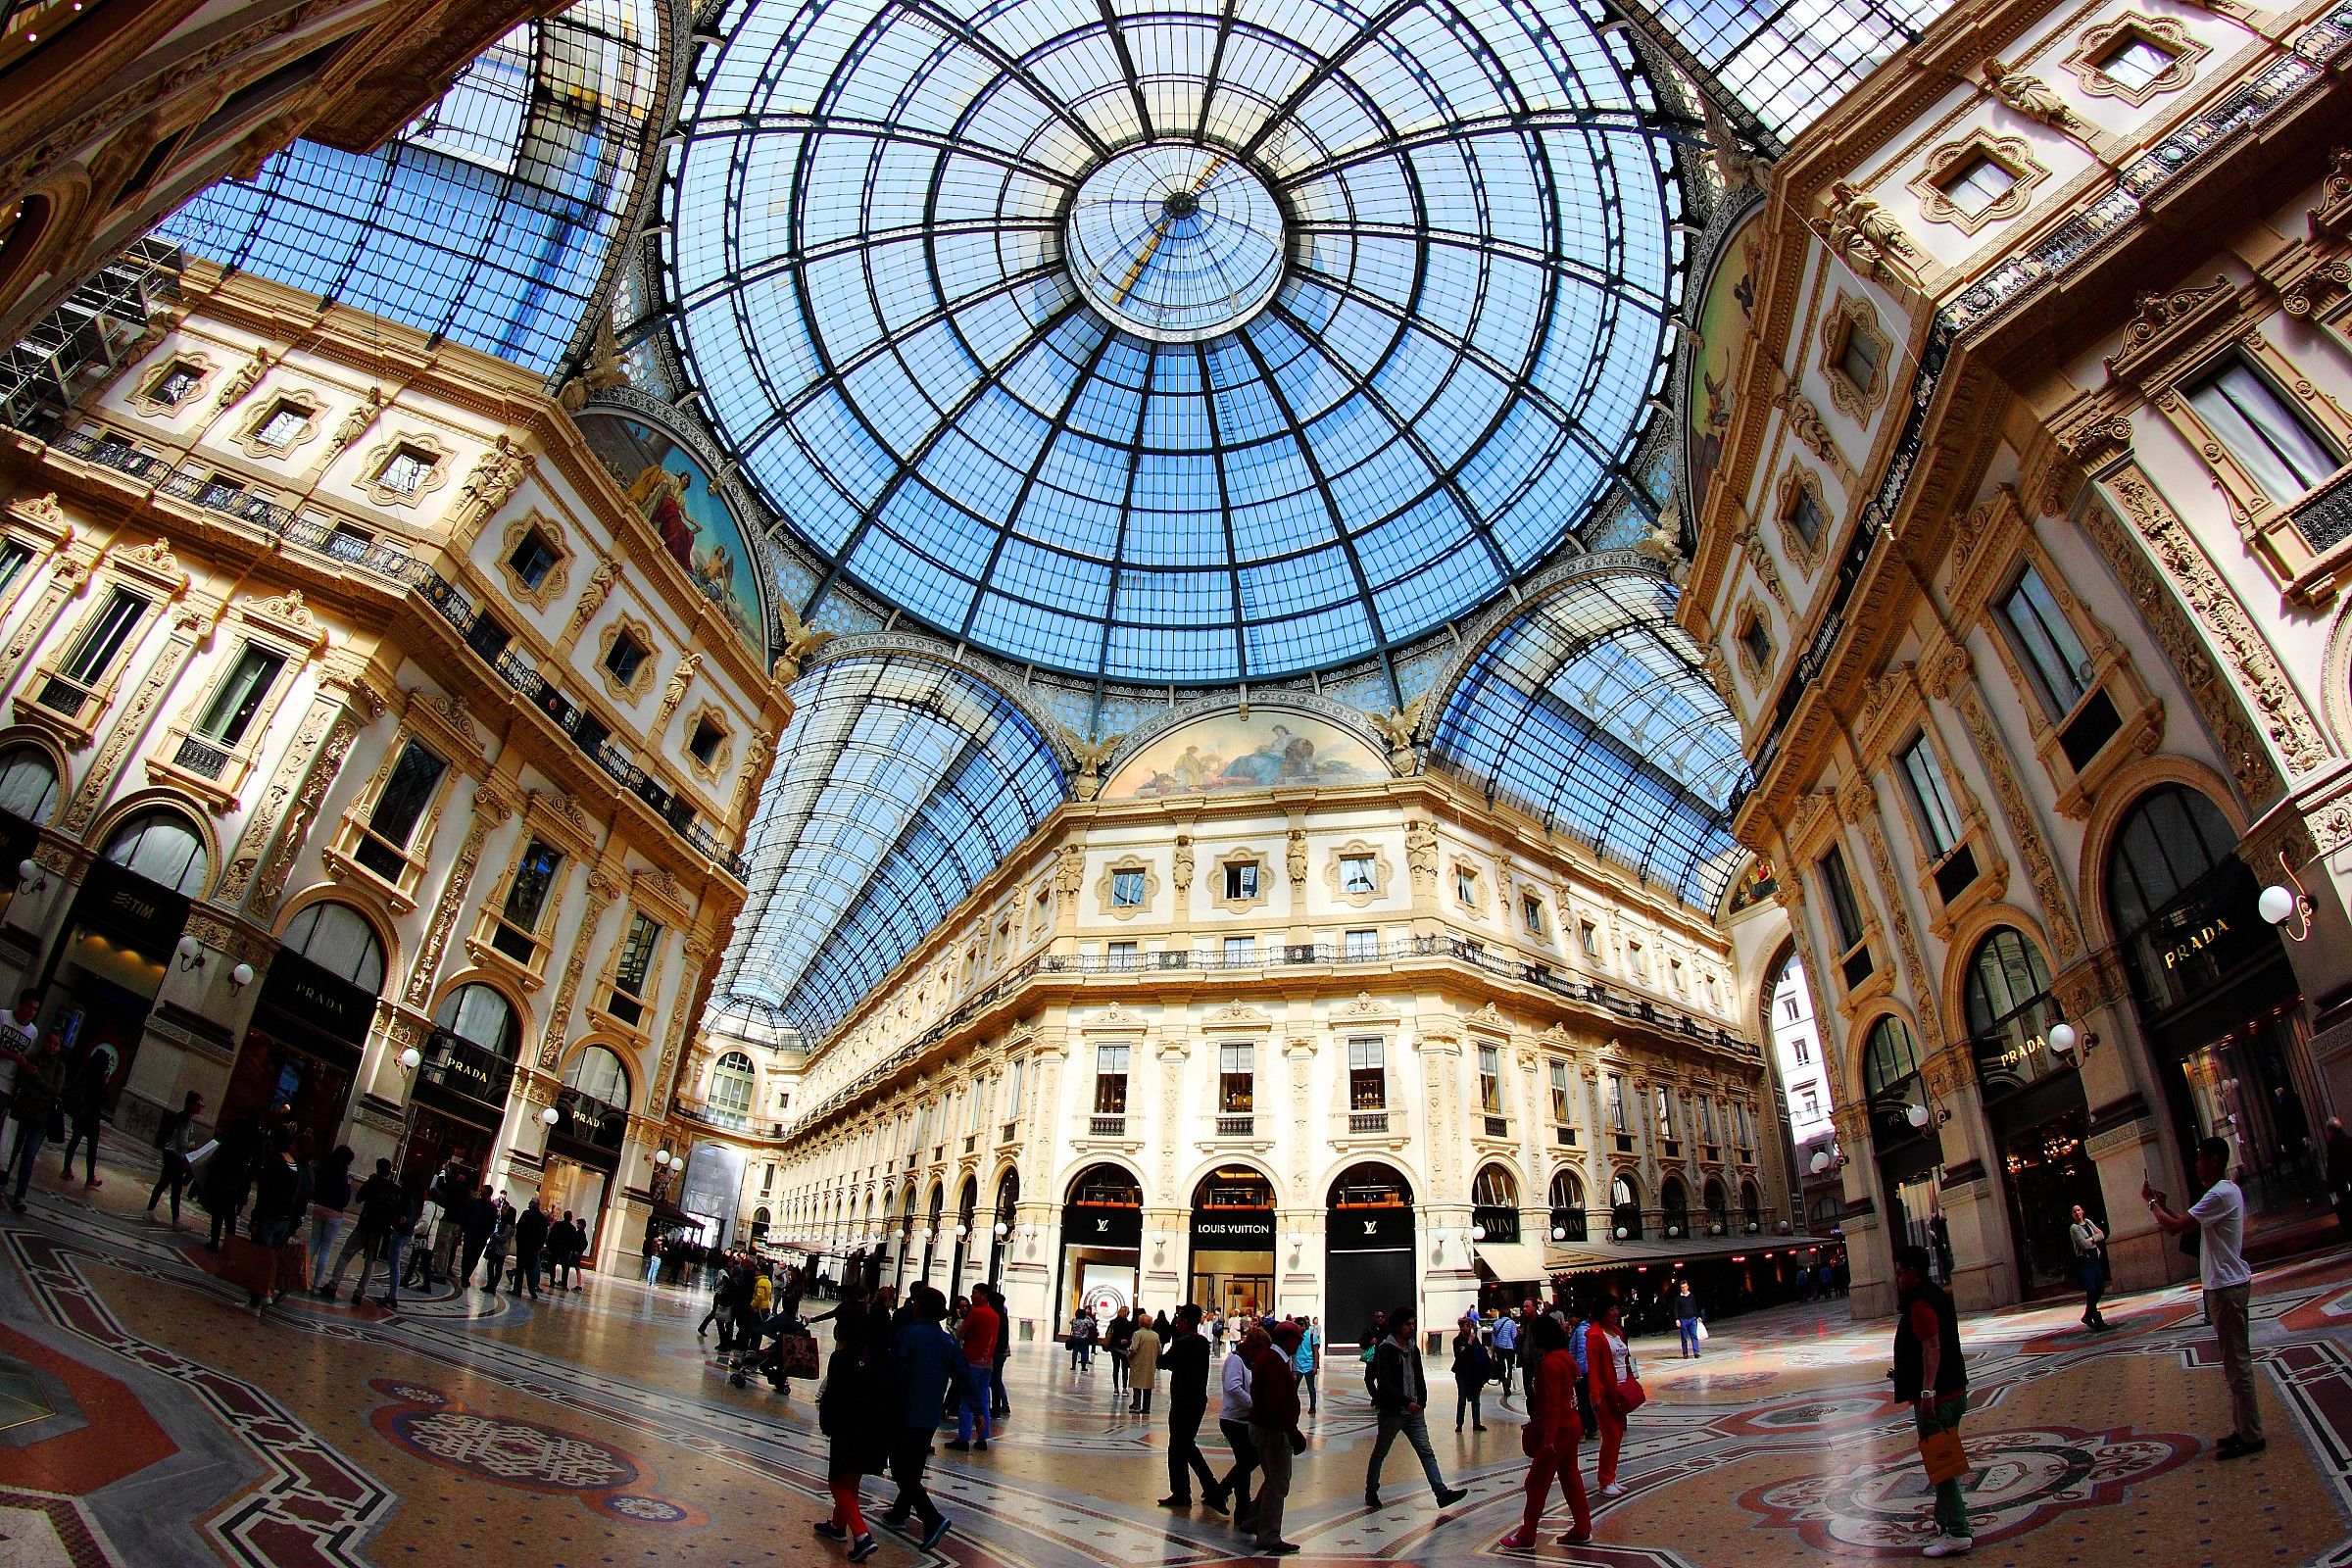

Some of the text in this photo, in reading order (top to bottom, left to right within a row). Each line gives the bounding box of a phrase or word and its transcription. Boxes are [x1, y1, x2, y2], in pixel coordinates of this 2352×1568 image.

[129, 899, 156, 919] TIM
[2164, 917, 2230, 969] PRADA
[296, 982, 343, 1015] PRADA
[2000, 1035, 2046, 1067] PRADA
[447, 1056, 487, 1083] PRADA
[572, 1110, 606, 1131] PRADA
[1198, 1224, 1270, 1234] LOUIS VUITTON
